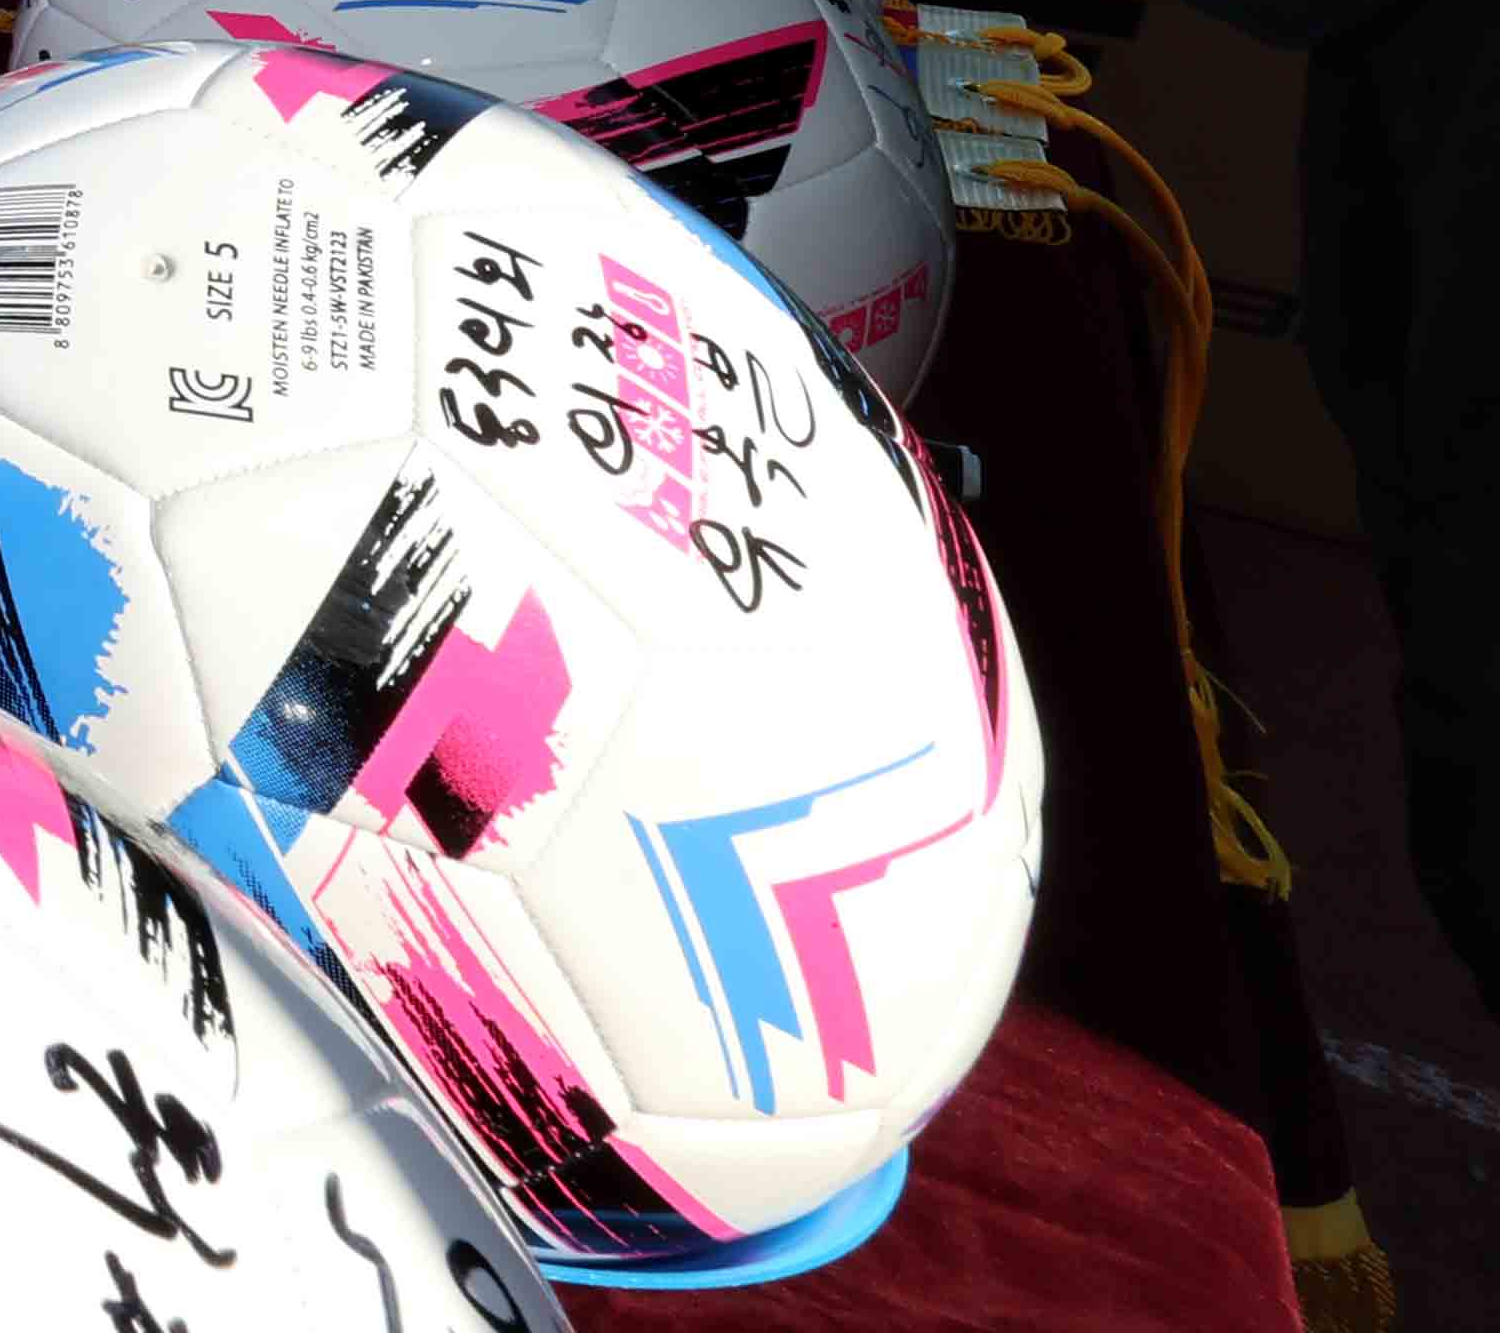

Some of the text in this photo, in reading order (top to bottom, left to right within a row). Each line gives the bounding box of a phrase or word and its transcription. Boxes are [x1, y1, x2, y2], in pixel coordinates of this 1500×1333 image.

[54, 189, 83, 349] 8 809753 610878
[204, 241, 238, 321] SIZE 5
[271, 179, 294, 396] MOISTEN NEEDLE INFLATE TO
[301, 265, 319, 315] 0.4-0.6
[303, 212, 322, 262] kg/cm2
[300, 319, 318, 342] lbs
[330, 231, 348, 370] STZ1-5W-VST2123
[357, 227, 376, 370] MADE IN PAKISTAN
